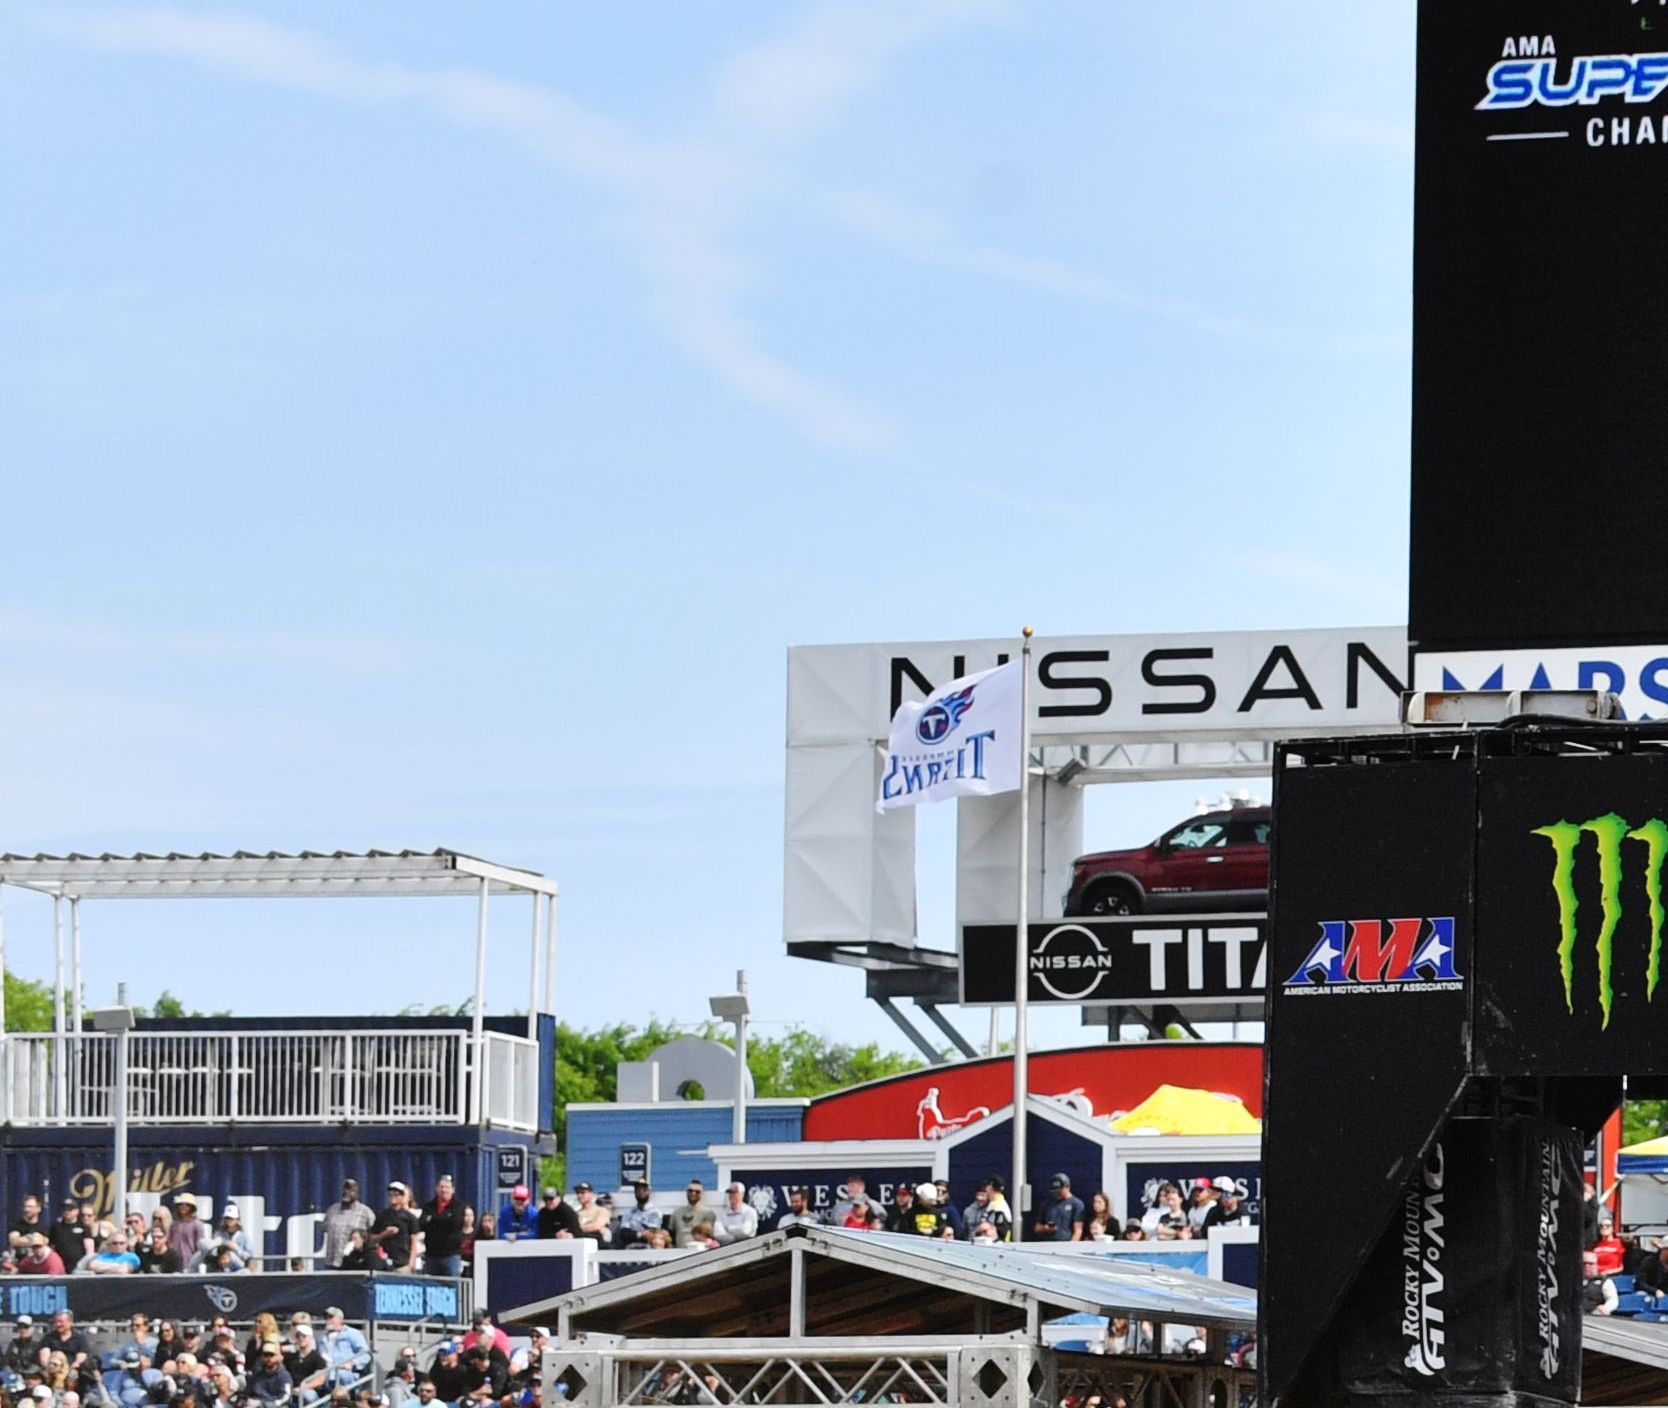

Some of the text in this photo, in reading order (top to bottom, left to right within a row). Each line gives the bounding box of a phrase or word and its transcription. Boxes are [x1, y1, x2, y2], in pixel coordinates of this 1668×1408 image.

[1501, 35, 1557, 57] AMA
[889, 642, 1408, 724] NSSAN
[1030, 954, 1112, 969] NISSAN
[1281, 916, 1465, 986] AMA
[1283, 981, 1464, 996] AMERICAN MOTORCYCLIST ASSOCIATION
[500, 1154, 521, 1168] 121
[622, 1152, 645, 1166] 122
[10, 1285, 68, 1315] TOUGH
[1402, 1266, 1421, 1339] ROCKY
